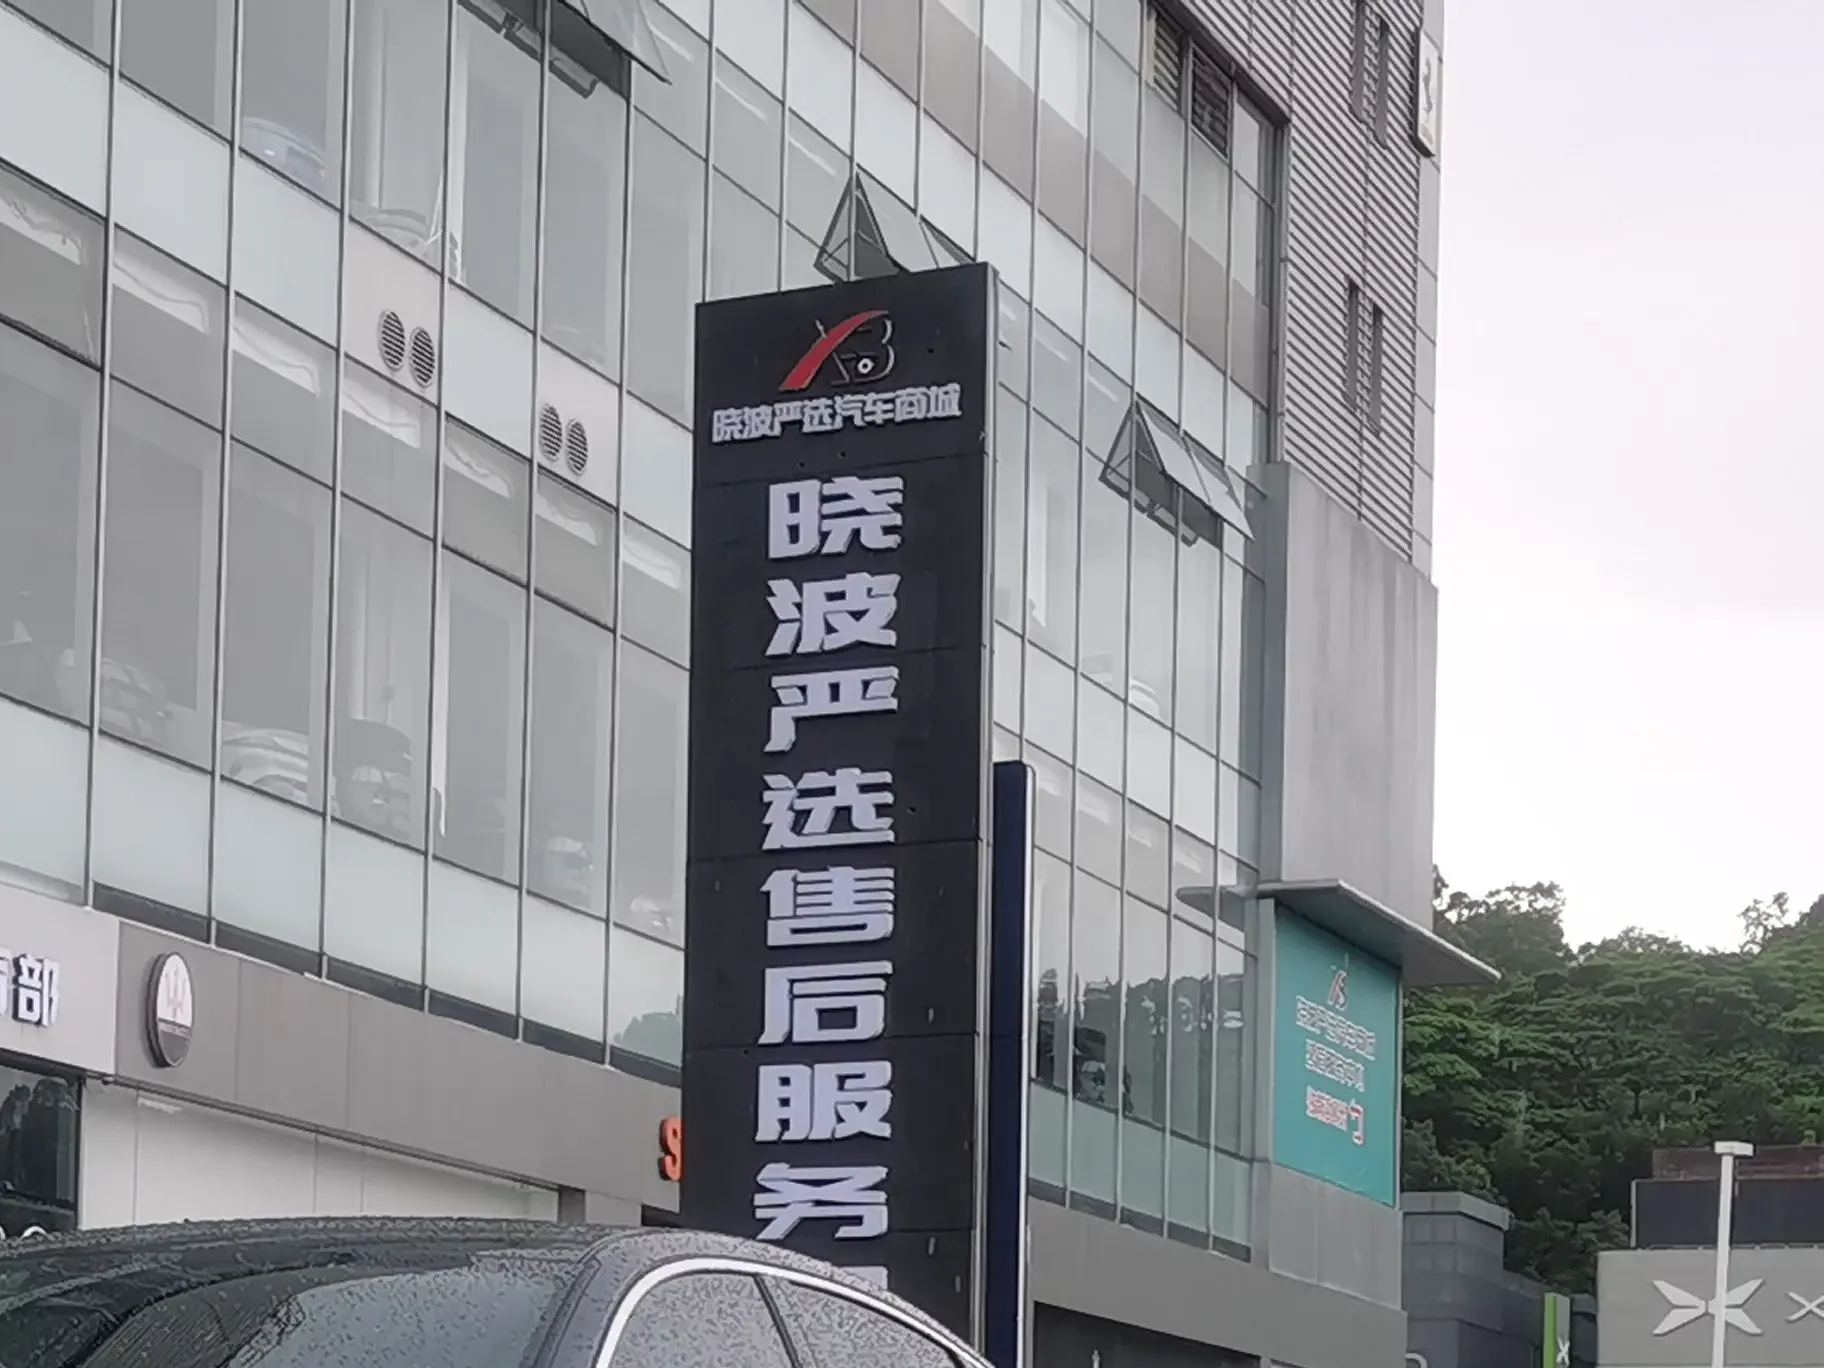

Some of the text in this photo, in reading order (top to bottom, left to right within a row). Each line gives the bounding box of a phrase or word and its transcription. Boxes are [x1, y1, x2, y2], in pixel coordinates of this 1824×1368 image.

[711, 383, 962, 444] 晓波严选汽车商城
[753, 475, 904, 1290] 晓波严选售后服务
